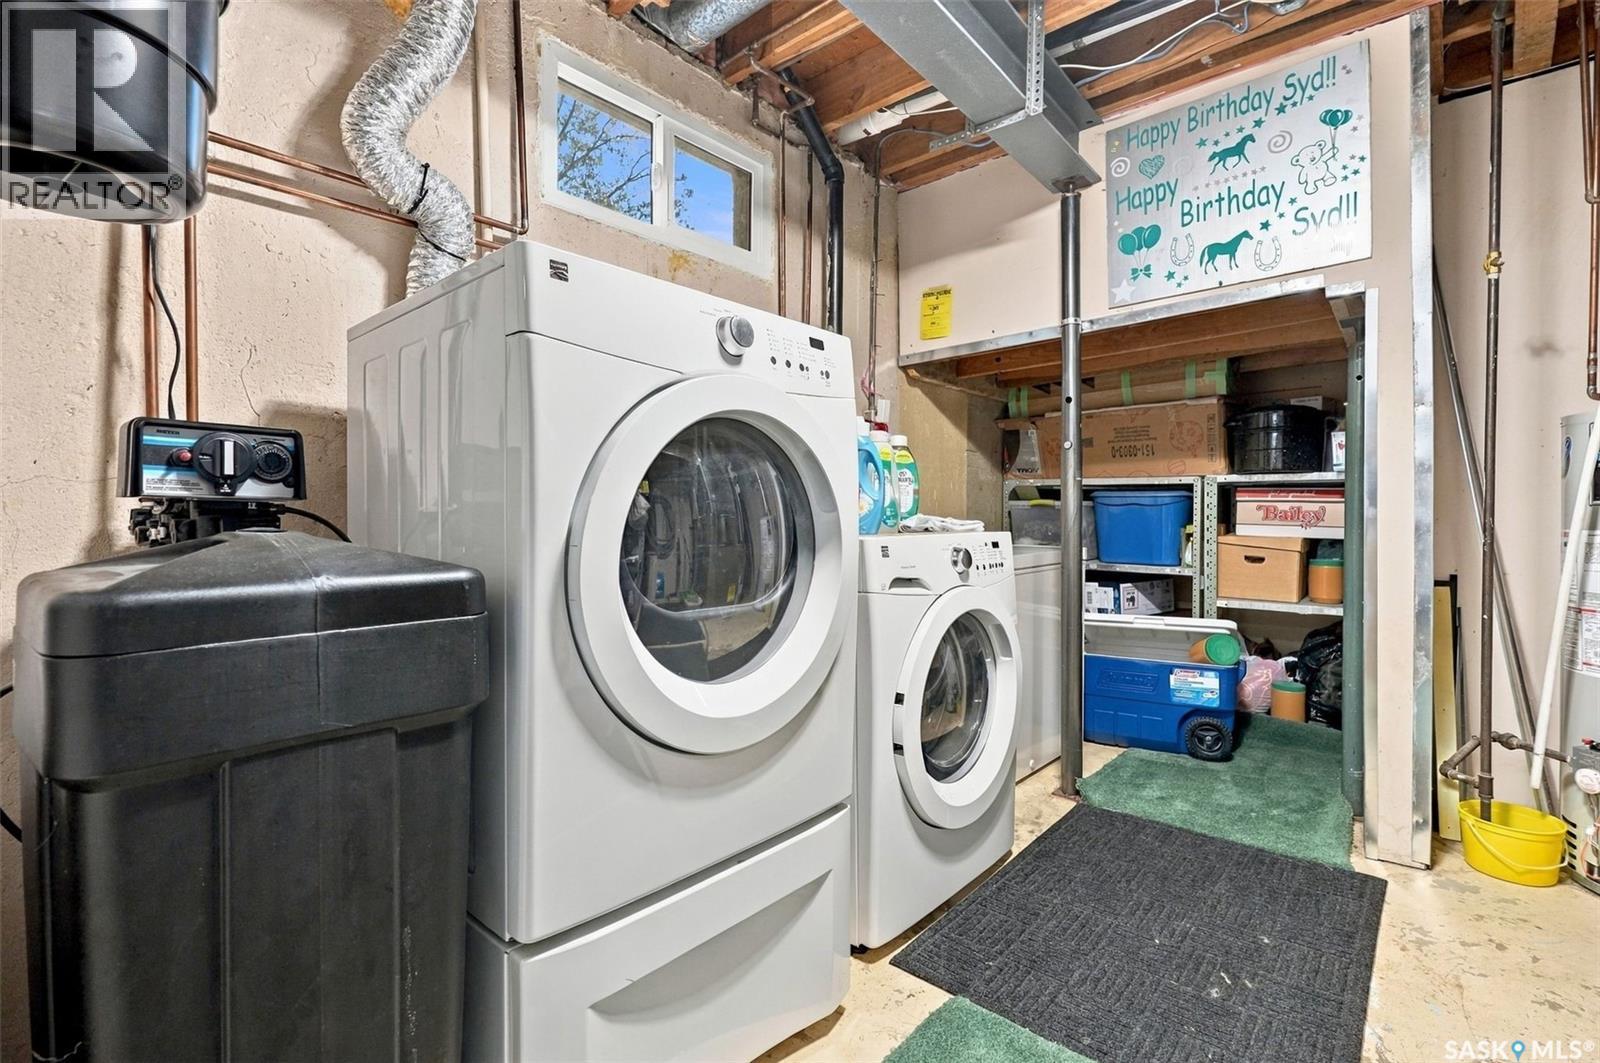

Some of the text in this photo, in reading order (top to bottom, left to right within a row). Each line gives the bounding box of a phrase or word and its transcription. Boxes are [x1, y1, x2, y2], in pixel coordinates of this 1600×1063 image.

[1127, 55, 1337, 152] Happy Birthday Syd!!
[1115, 177, 1179, 216] Happy
[1180, 178, 1286, 228] Birthday
